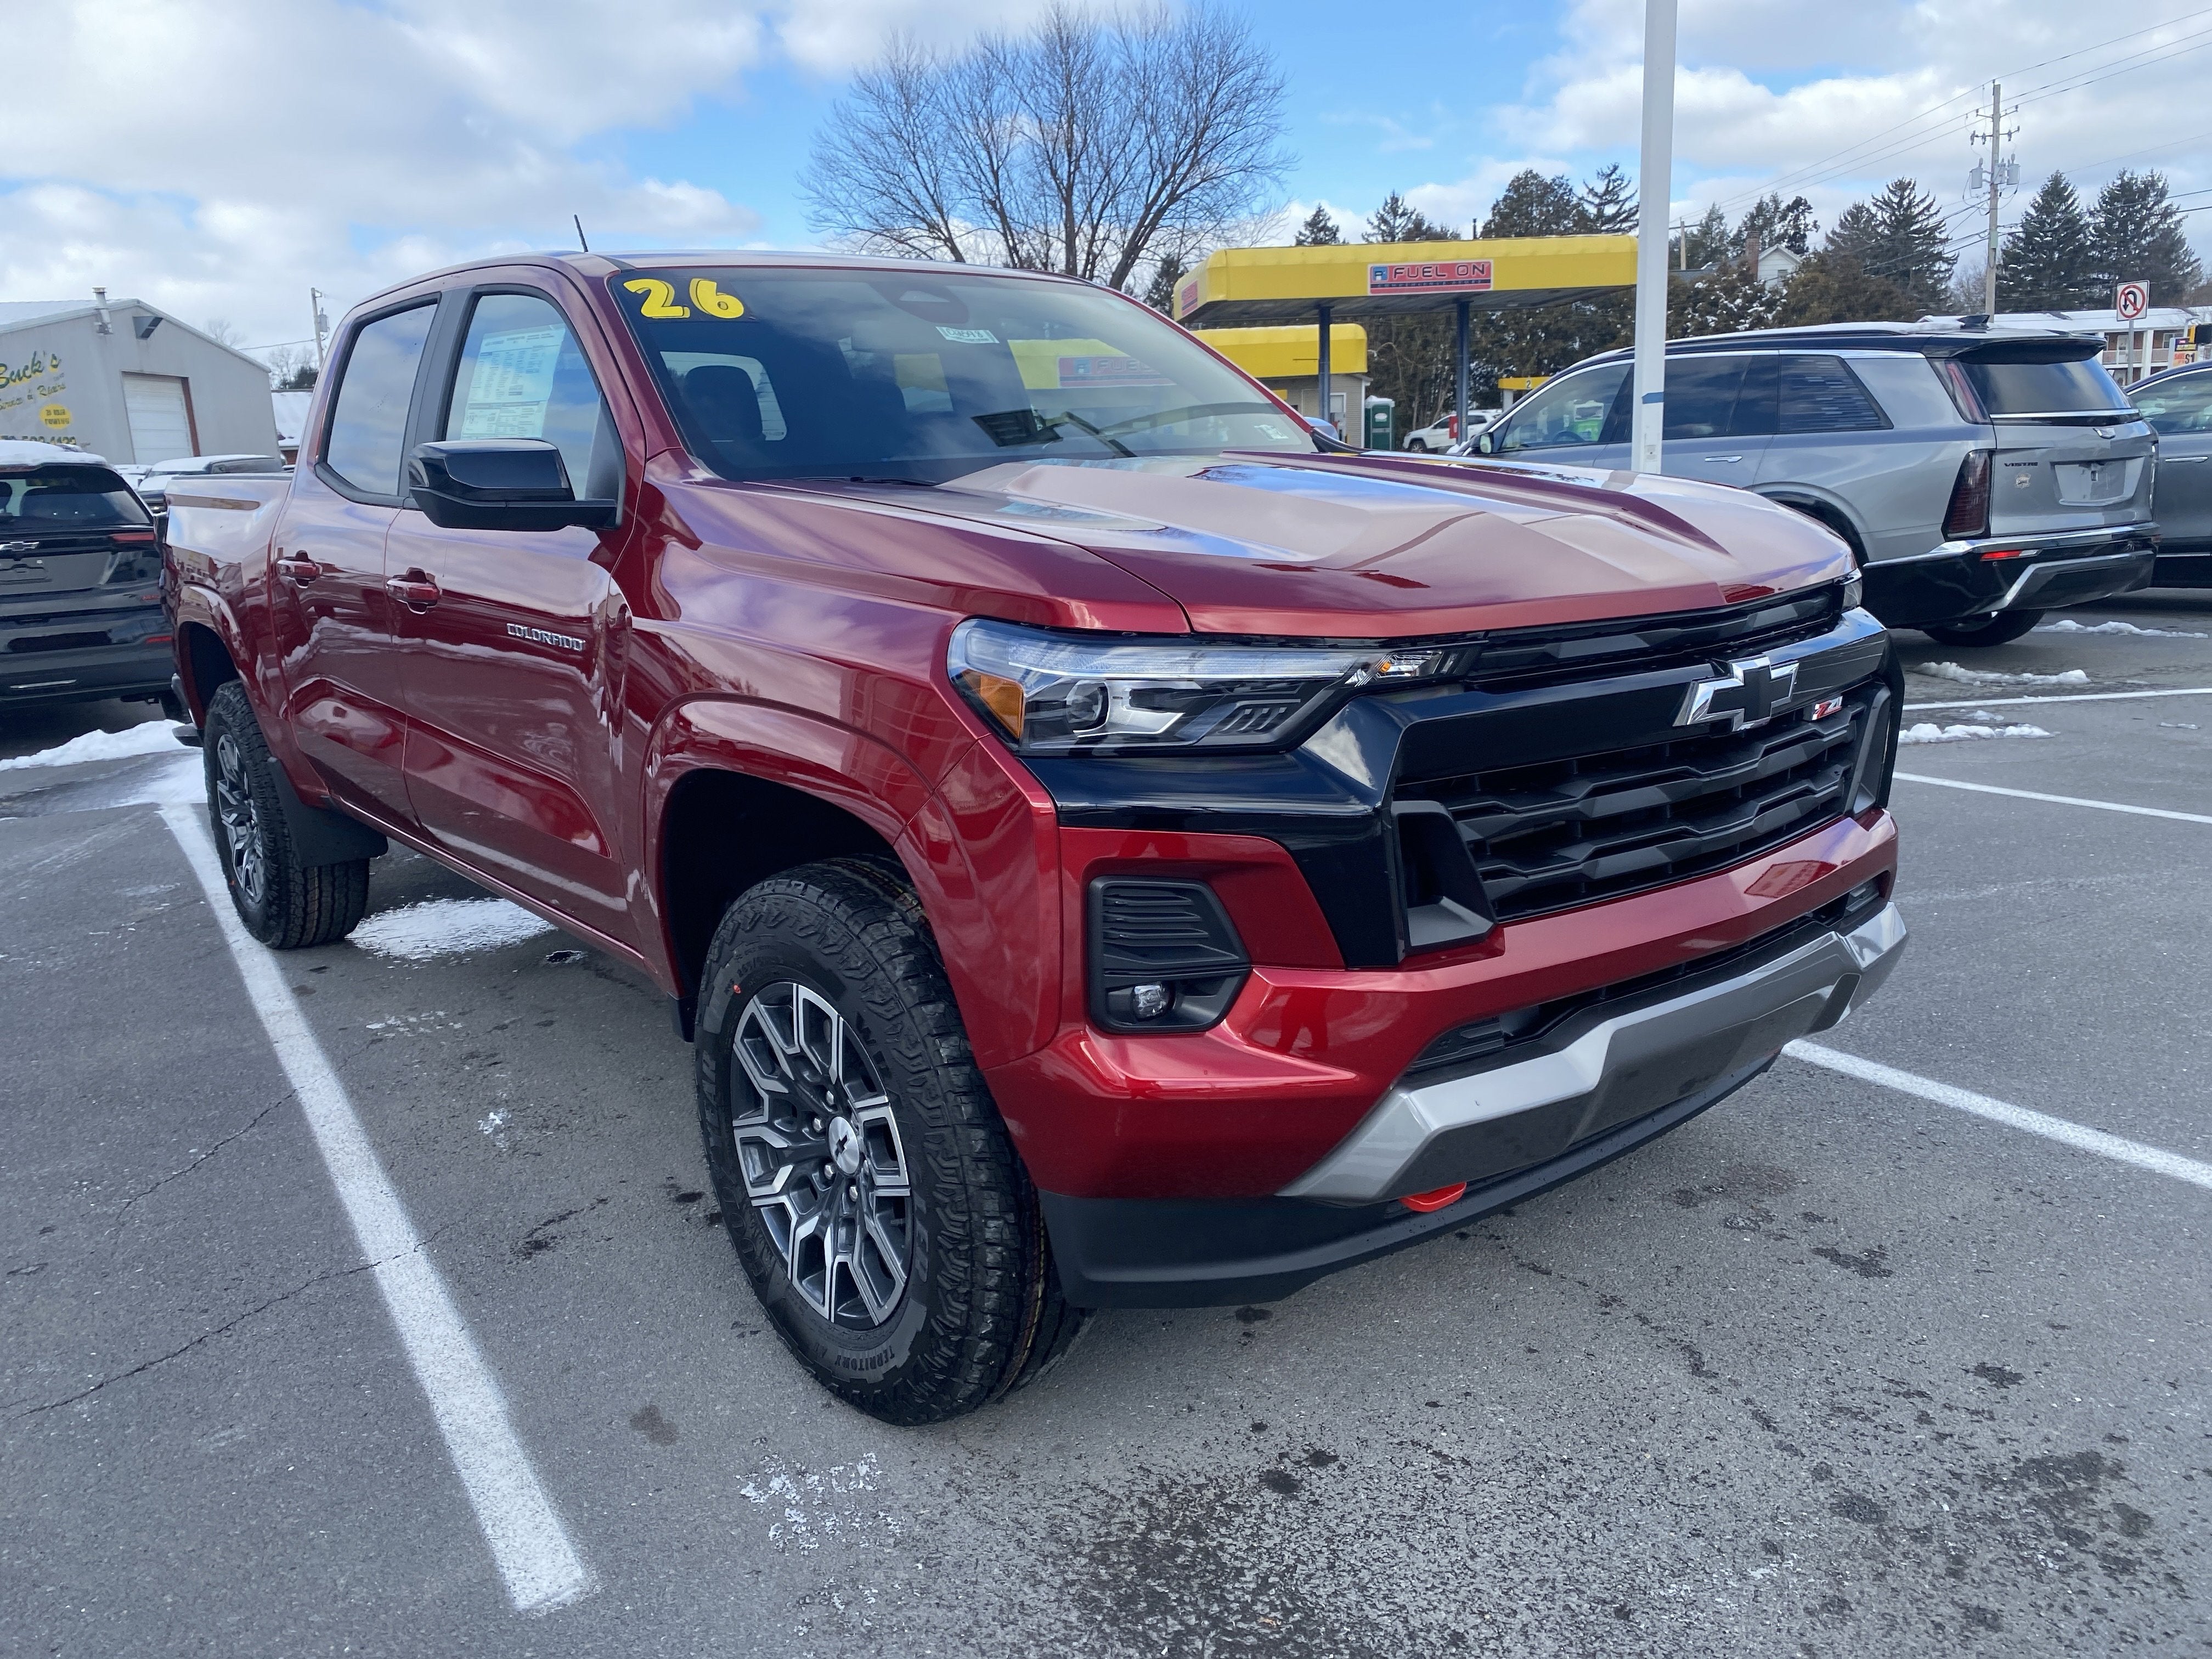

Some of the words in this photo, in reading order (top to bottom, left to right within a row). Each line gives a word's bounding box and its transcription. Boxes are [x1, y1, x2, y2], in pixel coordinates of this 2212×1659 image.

[1393, 266, 1447, 279] FUEL
[1456, 263, 1485, 276] ON
[623, 278, 744, 319] 26
[1526, 380, 1532, 389] 2
[506, 623, 586, 652] COLORADO
[834, 1345, 895, 1372] TERRITORY
